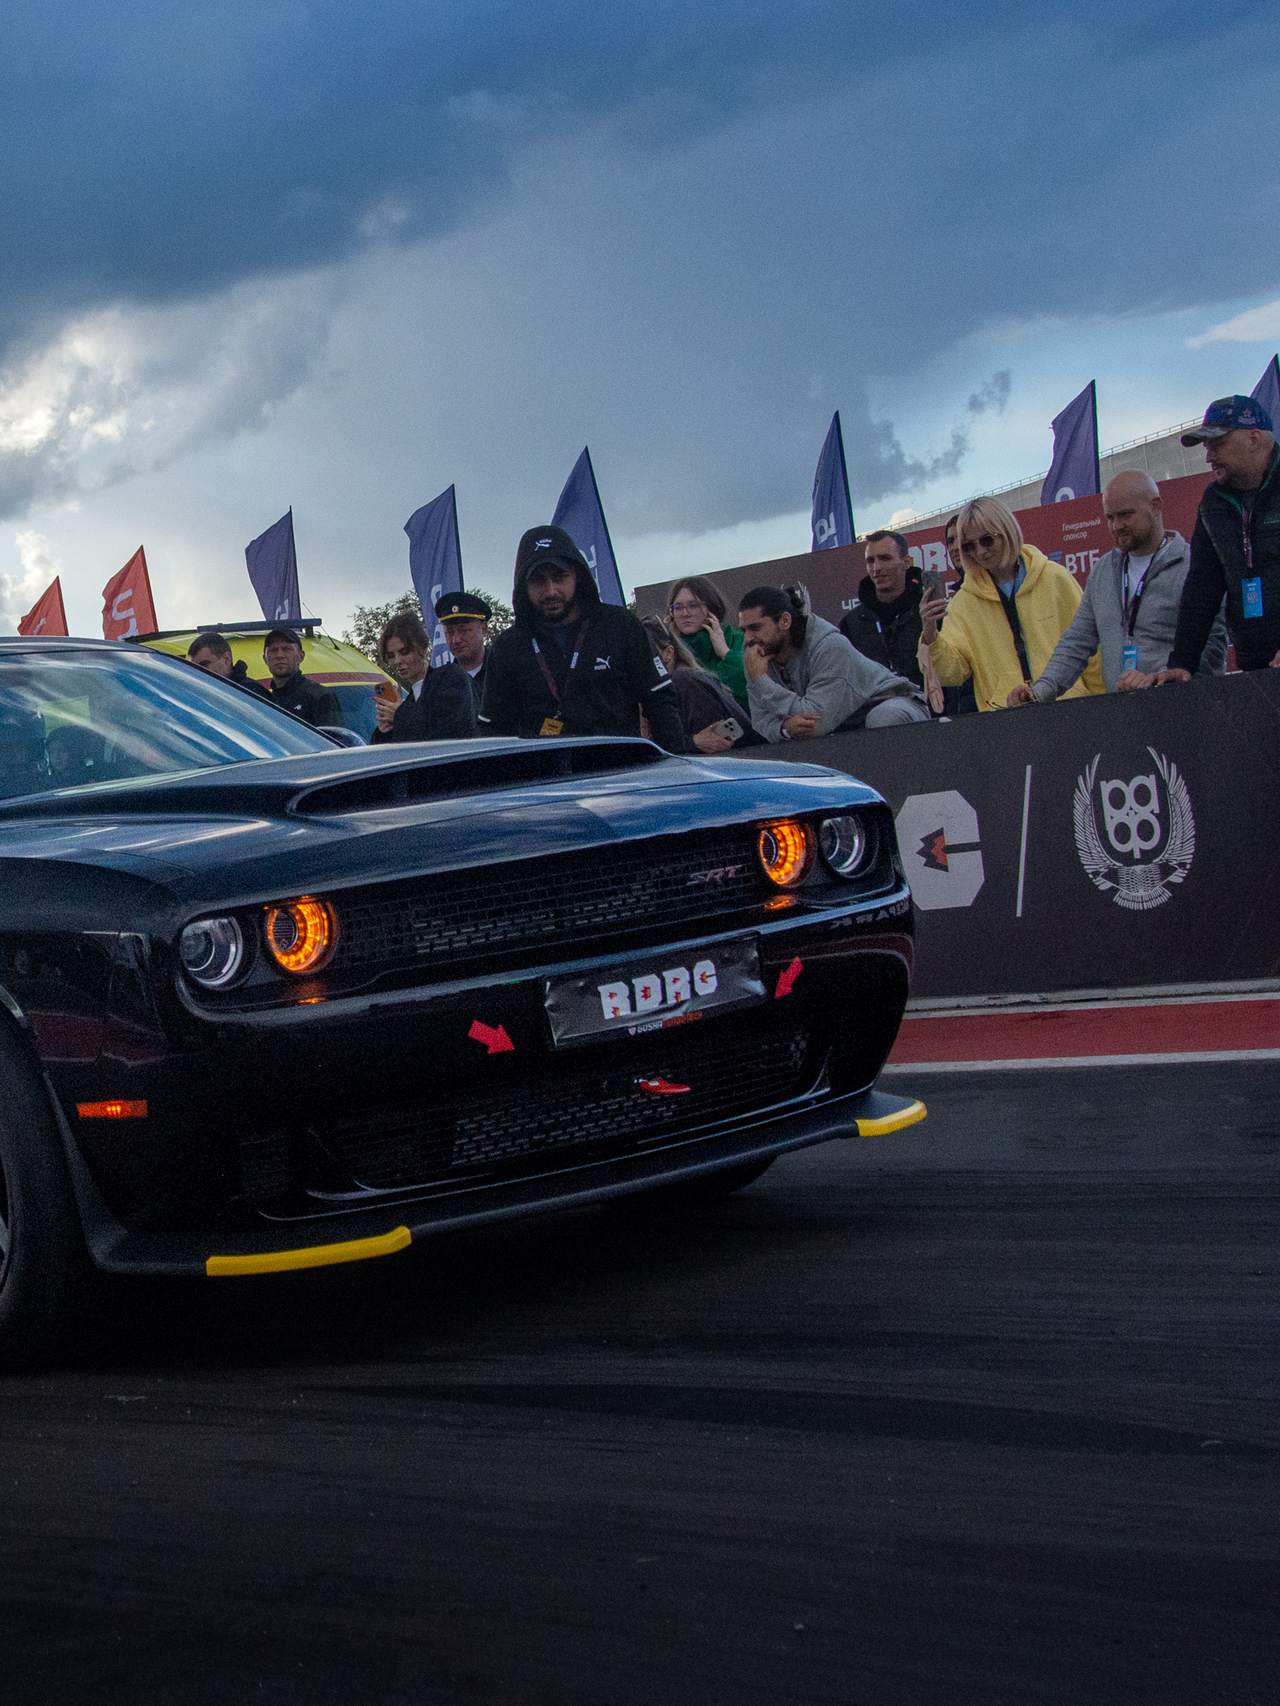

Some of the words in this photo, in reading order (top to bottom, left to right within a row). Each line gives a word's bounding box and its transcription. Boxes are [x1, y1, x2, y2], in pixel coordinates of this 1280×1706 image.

[1062, 516, 1101, 531] Генеральный
[1063, 531, 1087, 541] спонсор
[597, 959, 719, 1020] RDRC
